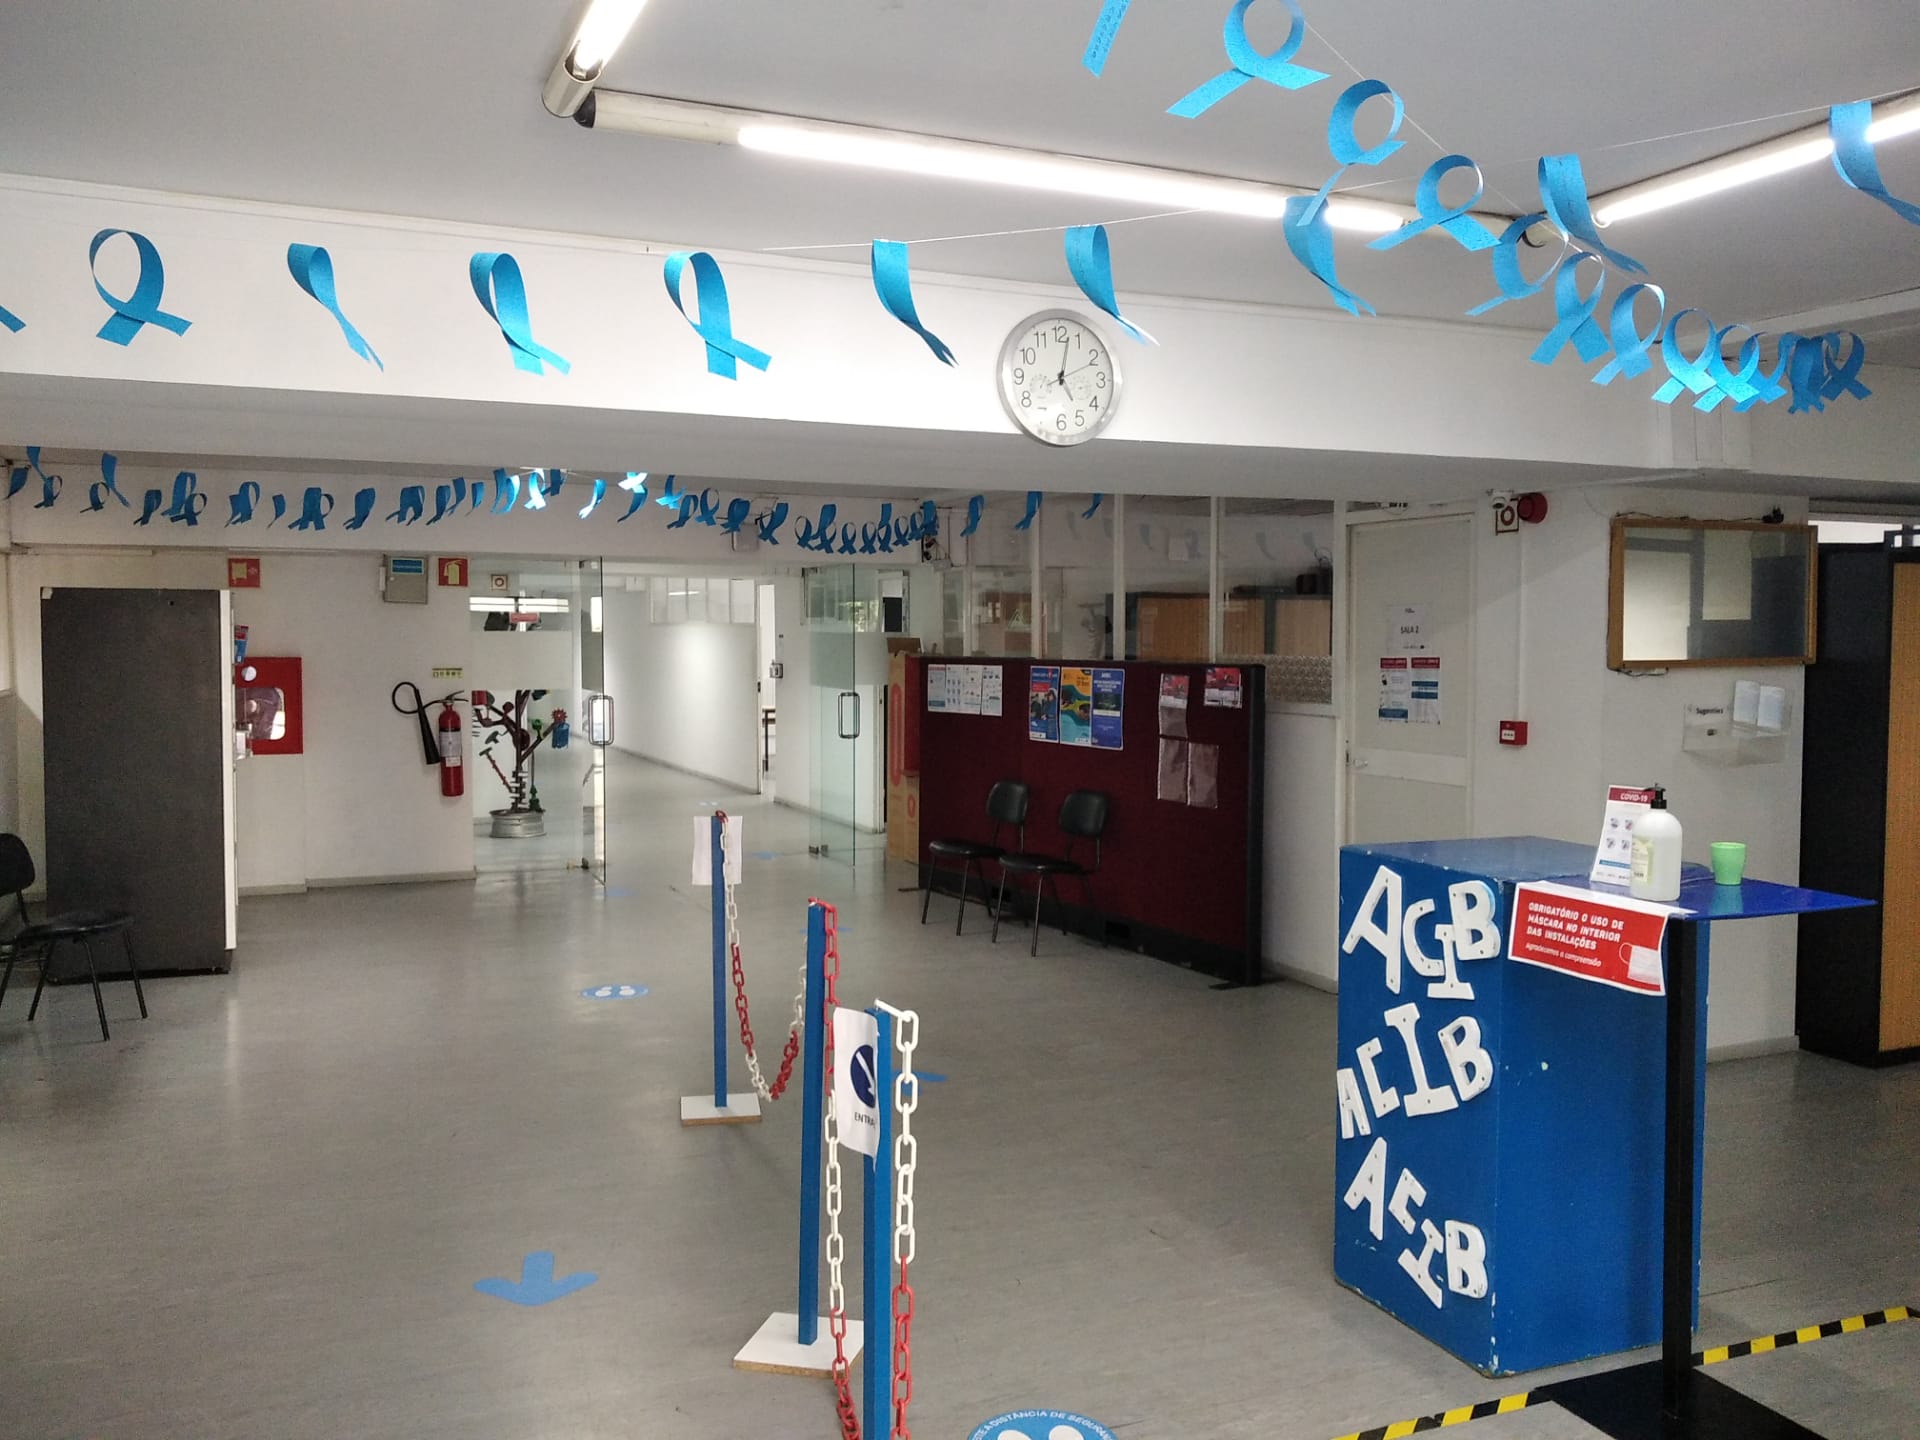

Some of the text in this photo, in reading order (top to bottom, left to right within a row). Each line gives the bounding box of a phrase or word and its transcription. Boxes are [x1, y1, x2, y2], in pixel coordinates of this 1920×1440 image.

[1034, 331, 1047, 349] 11
[1051, 325, 1068, 344] 12
[1075, 332, 1081, 349] 1
[1019, 347, 1036, 365] 10
[1088, 349, 1099, 366] 2
[1013, 368, 1025, 385] 9
[1096, 371, 1106, 389] 3
[1021, 391, 1032, 408] 8
[1089, 395, 1099, 412] 4
[1056, 413, 1067, 431] 6
[1074, 410, 1085, 427] 5
[1620, 793, 1648, 802] COVID-19
[1528, 902, 1624, 930] OBRIGATÓRIO O USO DE
[1528, 913, 1621, 943] MÁSCARA NO INTERIOR
[1527, 926, 1597, 950] DAS INSTALAÇÕES
[1337, 1002, 1494, 1139] ACIB
[854, 1111, 876, 1127] ENTRA
[1343, 1136, 1488, 1308] ACIB
[1050, 1411, 1065, 1419] DE
